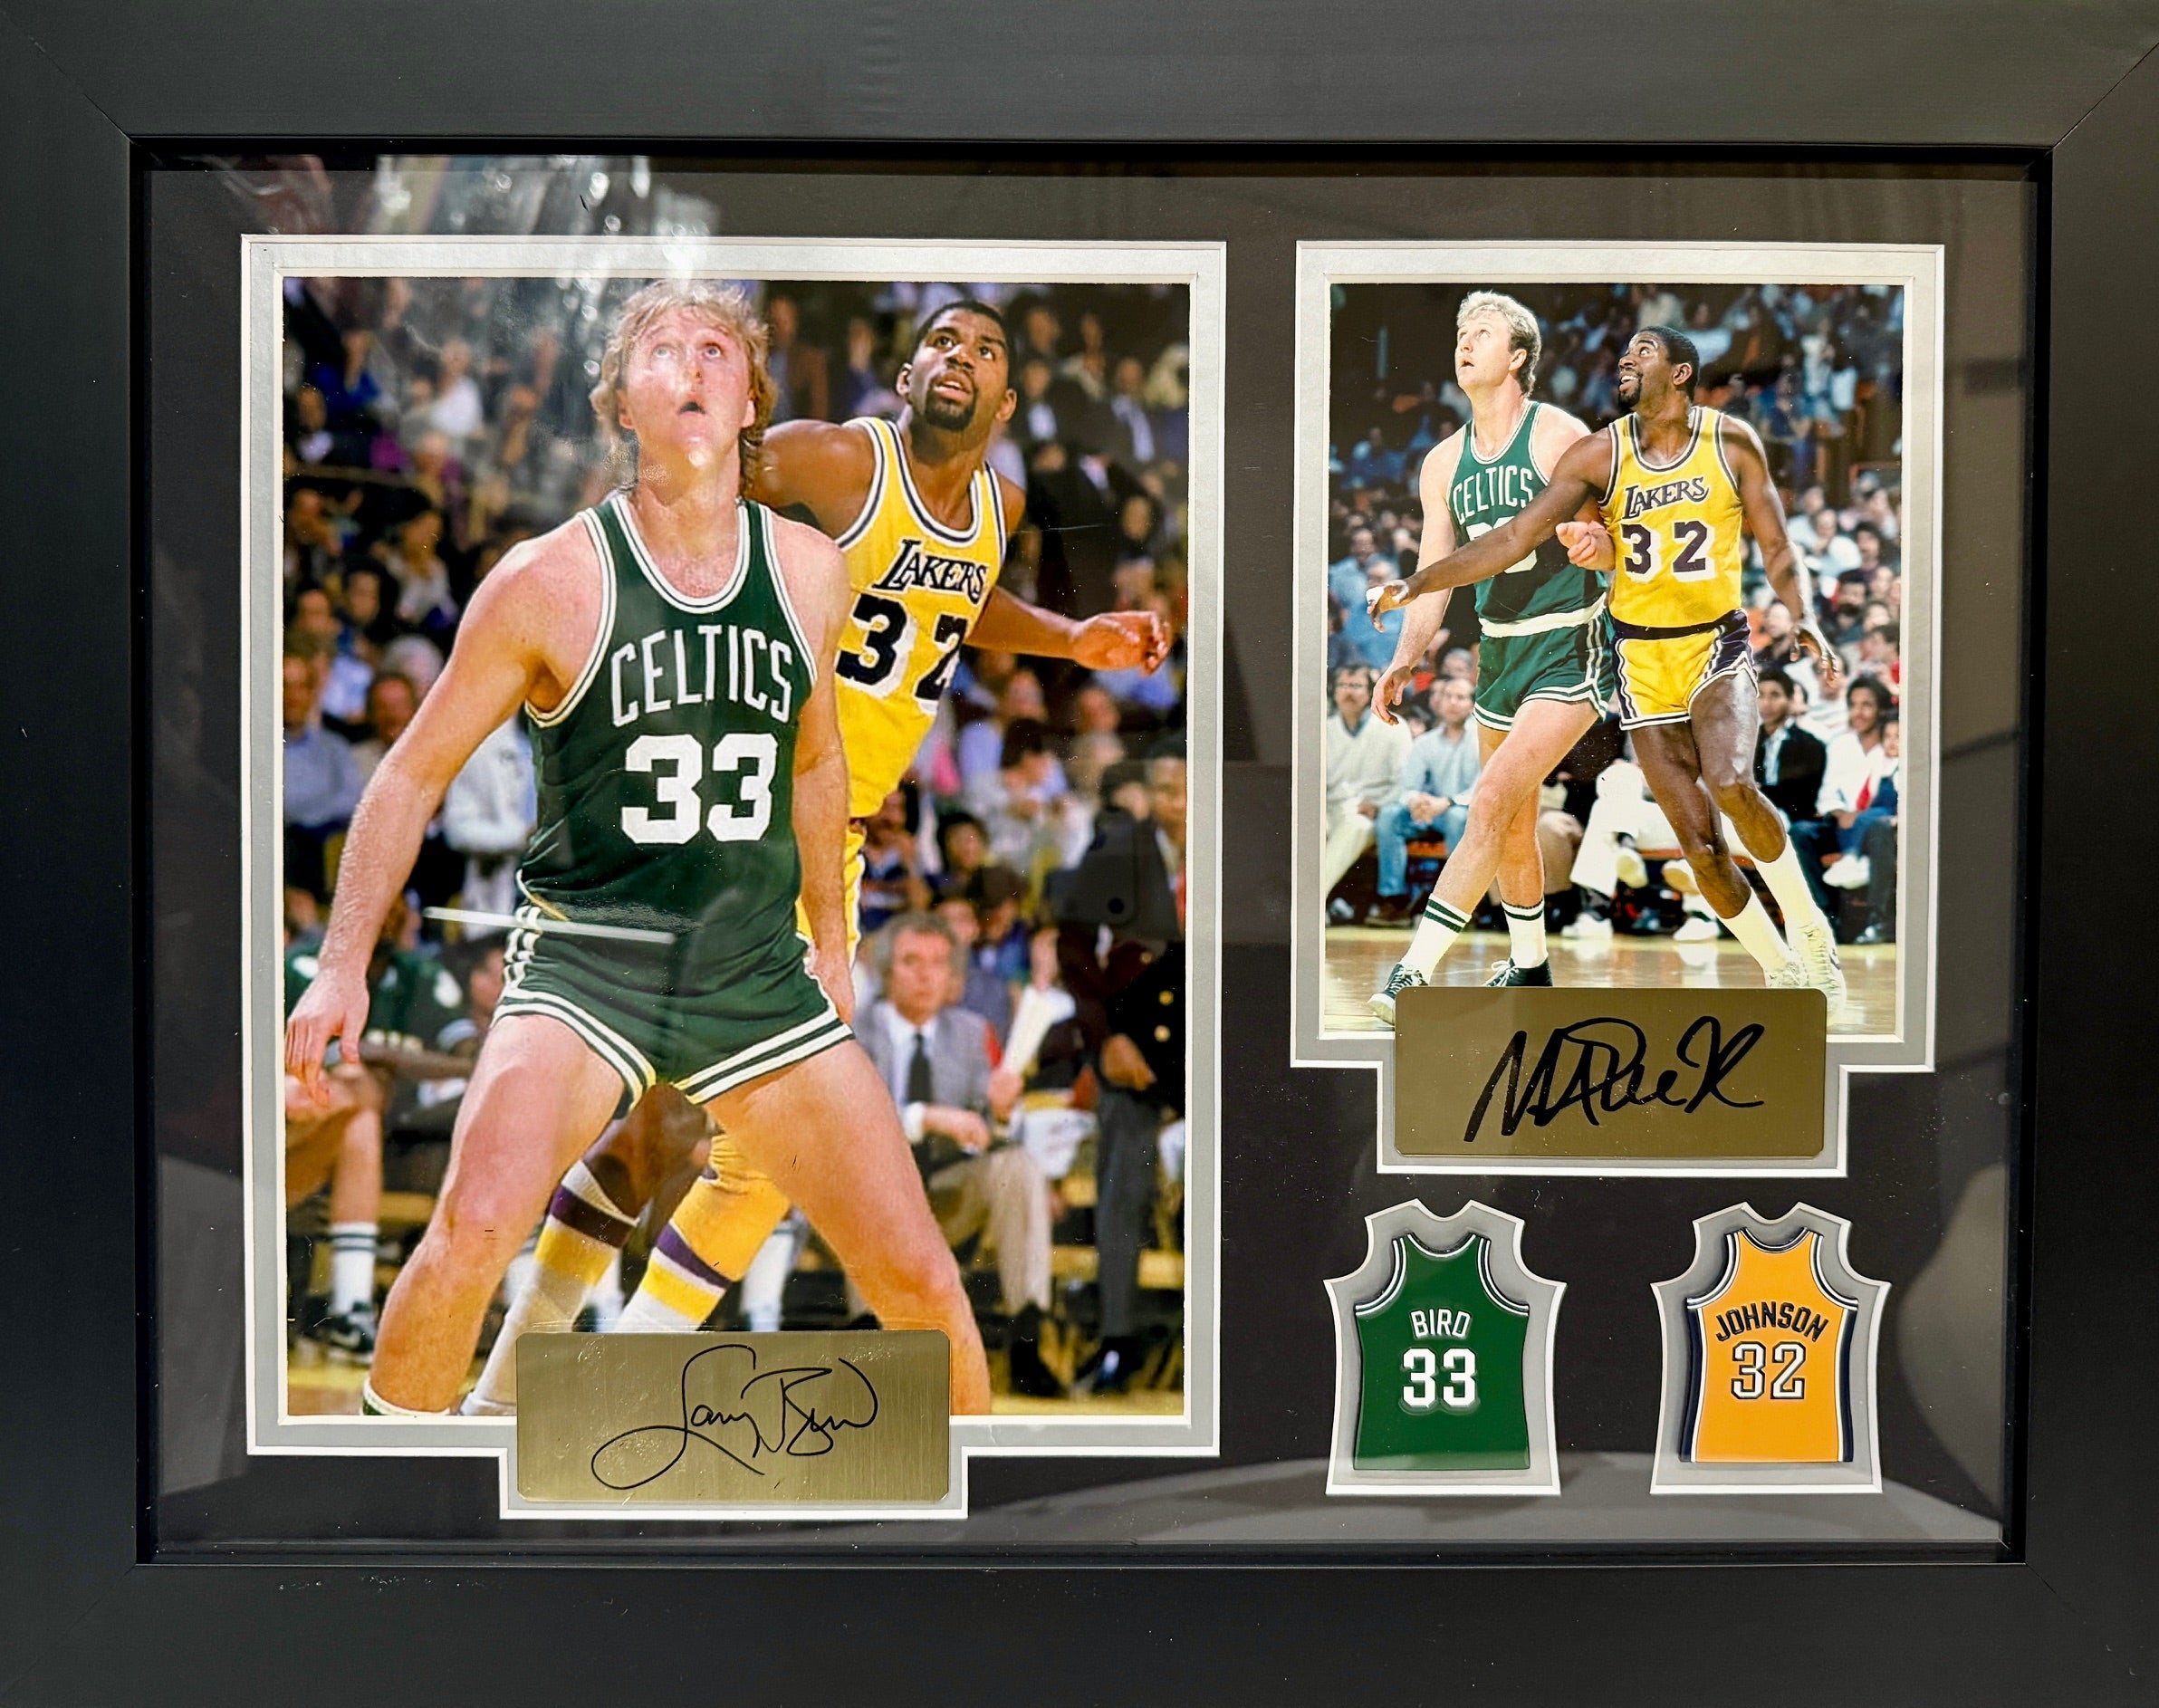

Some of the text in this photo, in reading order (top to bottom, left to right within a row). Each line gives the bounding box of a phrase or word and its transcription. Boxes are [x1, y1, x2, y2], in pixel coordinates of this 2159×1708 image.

[1453, 464, 1534, 526] CELTICS
[1621, 475, 1711, 521] LAKERS
[871, 538, 991, 605] LAKERS
[1620, 520, 1717, 582] 32
[610, 624, 793, 727] CELTICS
[835, 594, 969, 714] 32
[620, 732, 779, 845] 33
[1409, 1308, 1473, 1340] BIRD
[1714, 1300, 1830, 1344] JOHNSON
[1401, 1347, 1478, 1409] 33
[1731, 1340, 1808, 1401] 32
